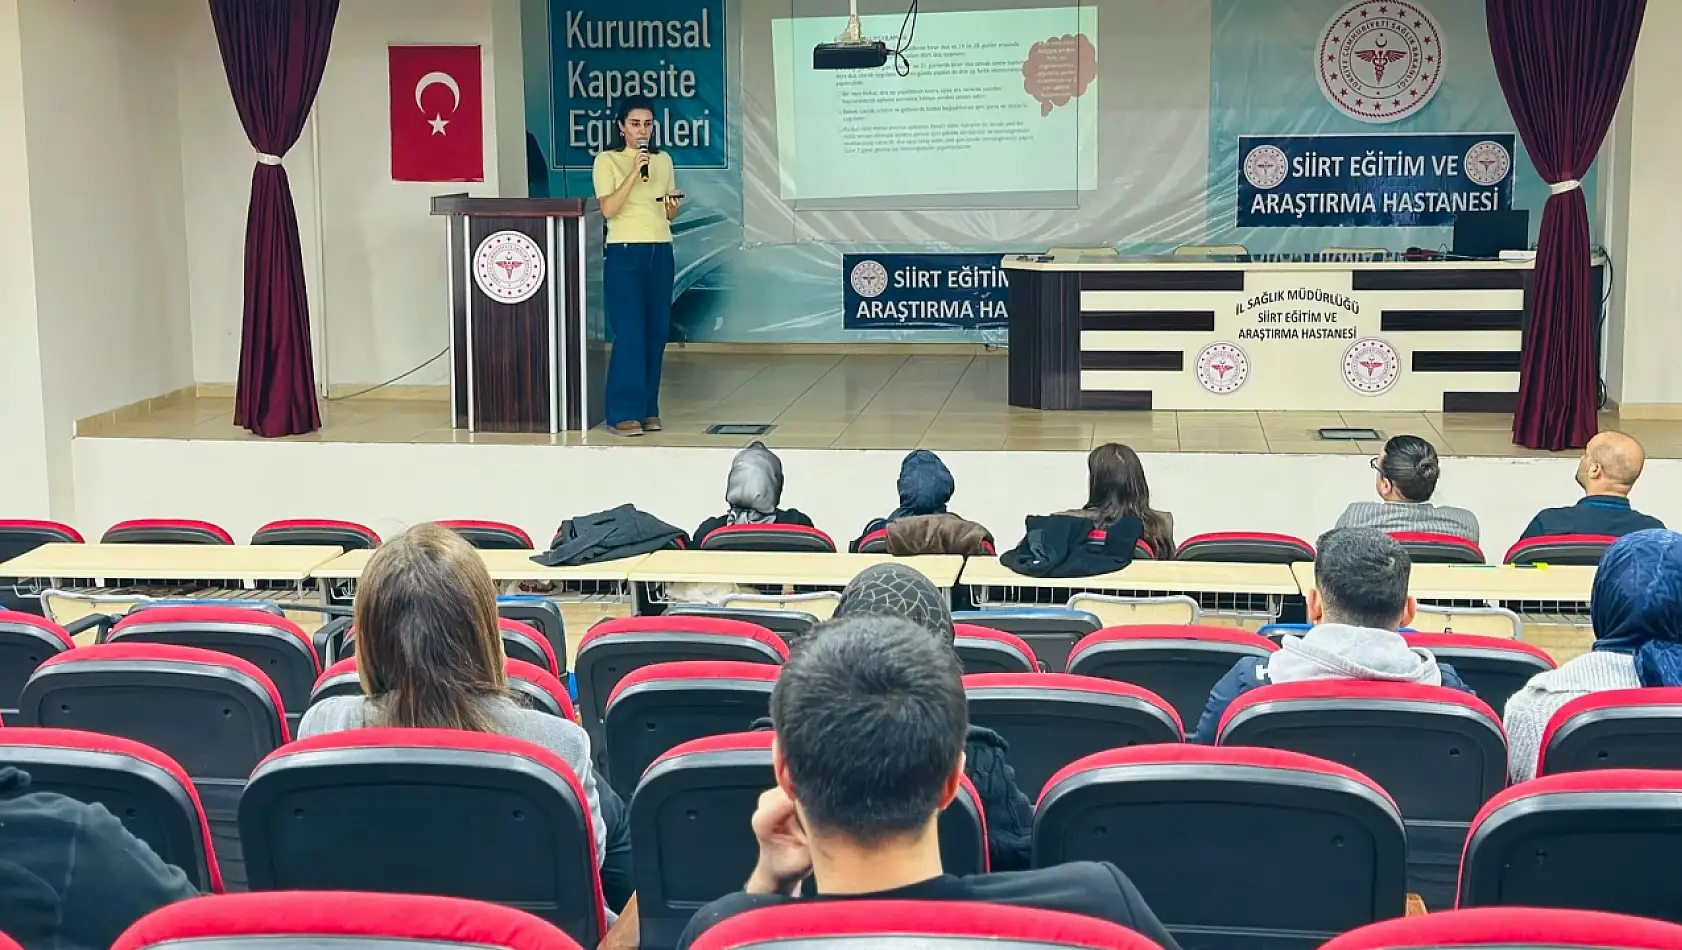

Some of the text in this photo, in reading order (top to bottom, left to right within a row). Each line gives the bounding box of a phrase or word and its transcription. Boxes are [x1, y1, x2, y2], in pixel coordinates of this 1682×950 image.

[566, 7, 711, 48] Kurumsal
[568, 60, 696, 107] Kapasite
[569, 107, 710, 156] Eğileri
[1292, 152, 1344, 177] SİİRT
[1350, 150, 1425, 177] EĞİTİM
[1432, 155, 1458, 176] VE
[1251, 186, 1499, 219] ARAŞTIRMA HASTANESİ
[894, 266, 942, 288] SİİRT
[856, 300, 975, 322] ARAŞTIRMA
[1247, 290, 1285, 310] SAĞLIK
[1287, 287, 1360, 315] MÜDÜRLÜĞÜ
[1258, 309, 1338, 323] SİİRT EĞİTİM VE
[1238, 325, 1357, 341] ARAŞTIRMA HASTANESİ
